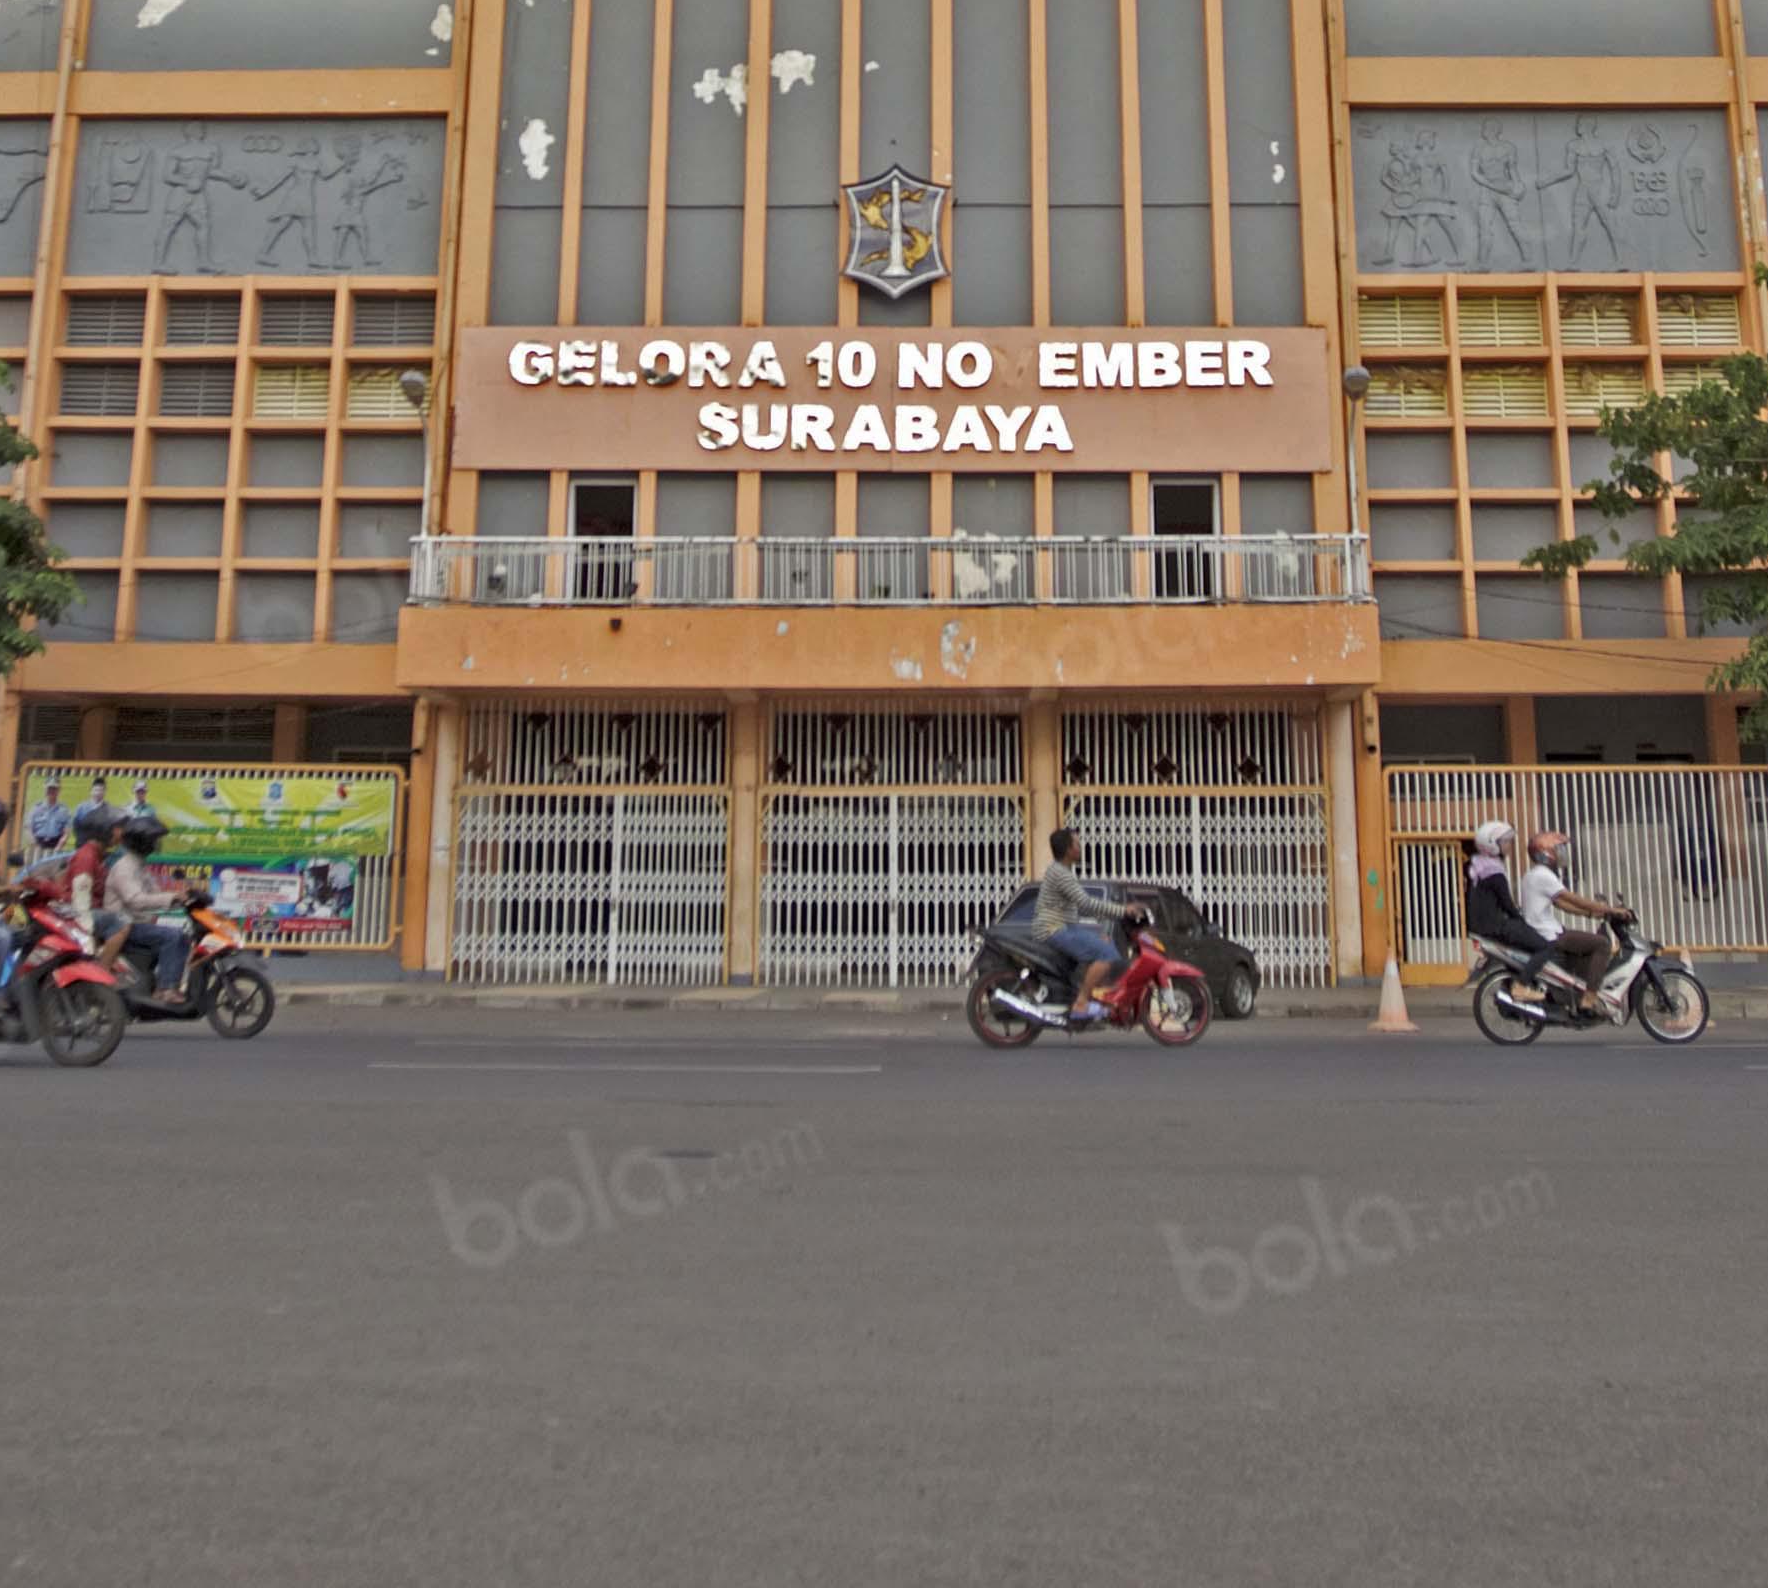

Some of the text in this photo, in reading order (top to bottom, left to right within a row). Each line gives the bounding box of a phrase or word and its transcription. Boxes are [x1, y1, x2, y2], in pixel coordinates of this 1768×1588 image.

[508, 338, 787, 389] GELORA
[805, 340, 878, 388] 10
[697, 401, 1075, 453] SURABAYA
